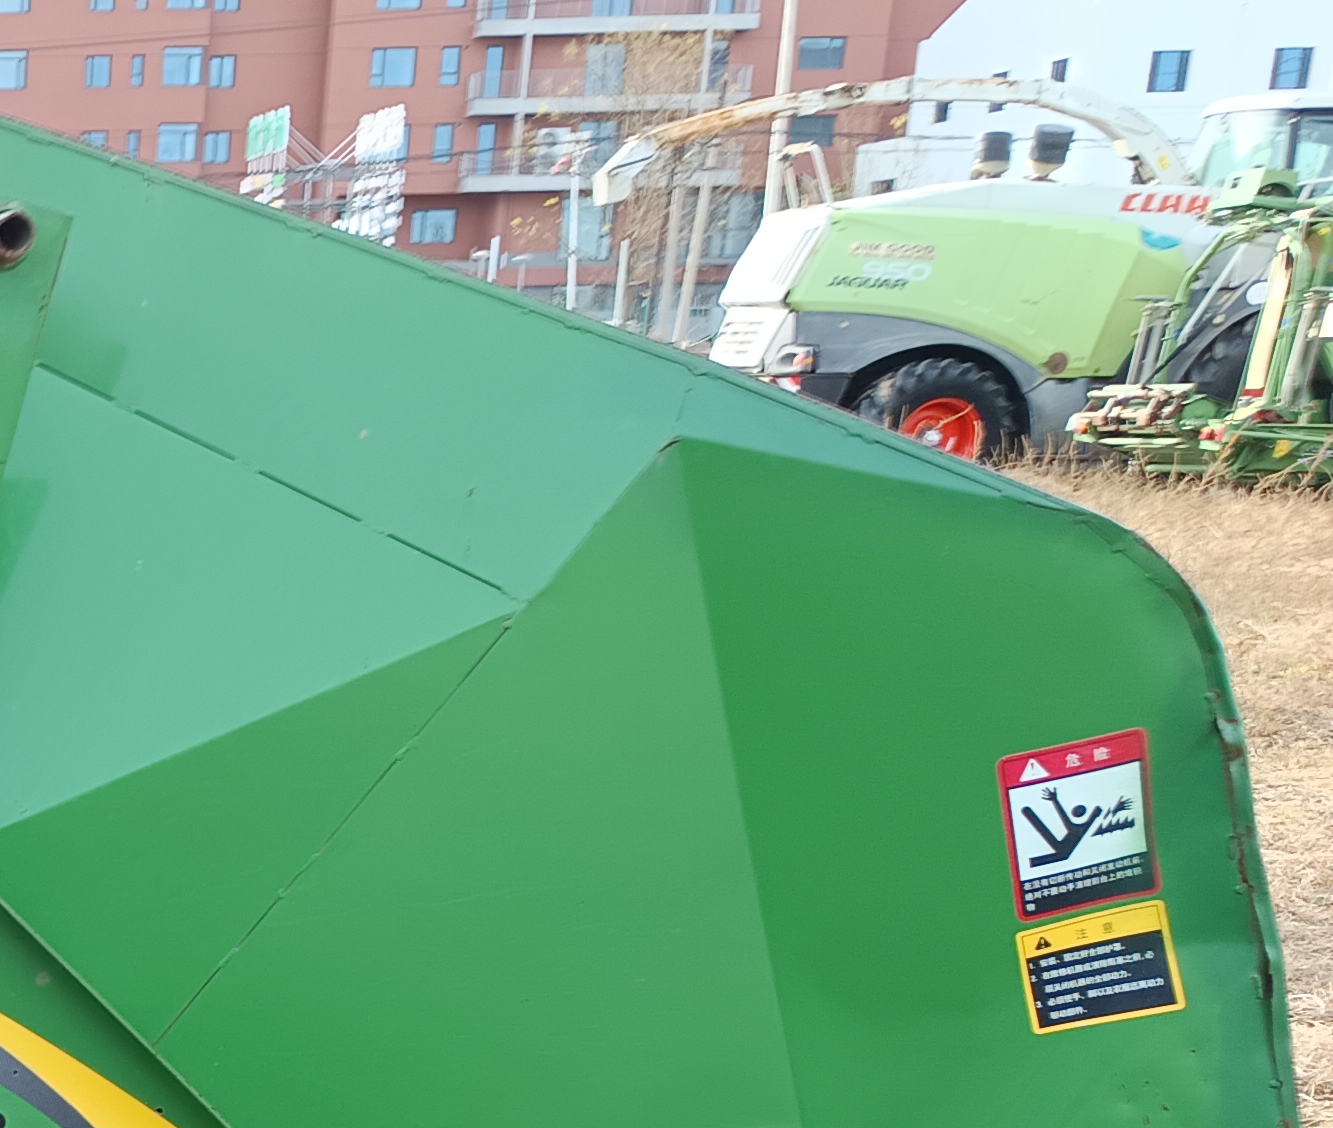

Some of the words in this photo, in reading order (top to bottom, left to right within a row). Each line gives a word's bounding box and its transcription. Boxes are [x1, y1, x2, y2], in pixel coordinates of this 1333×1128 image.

[862, 259, 933, 282] 950
[826, 275, 909, 291] JAGUAR
[1064, 746, 1111, 768] 危险
